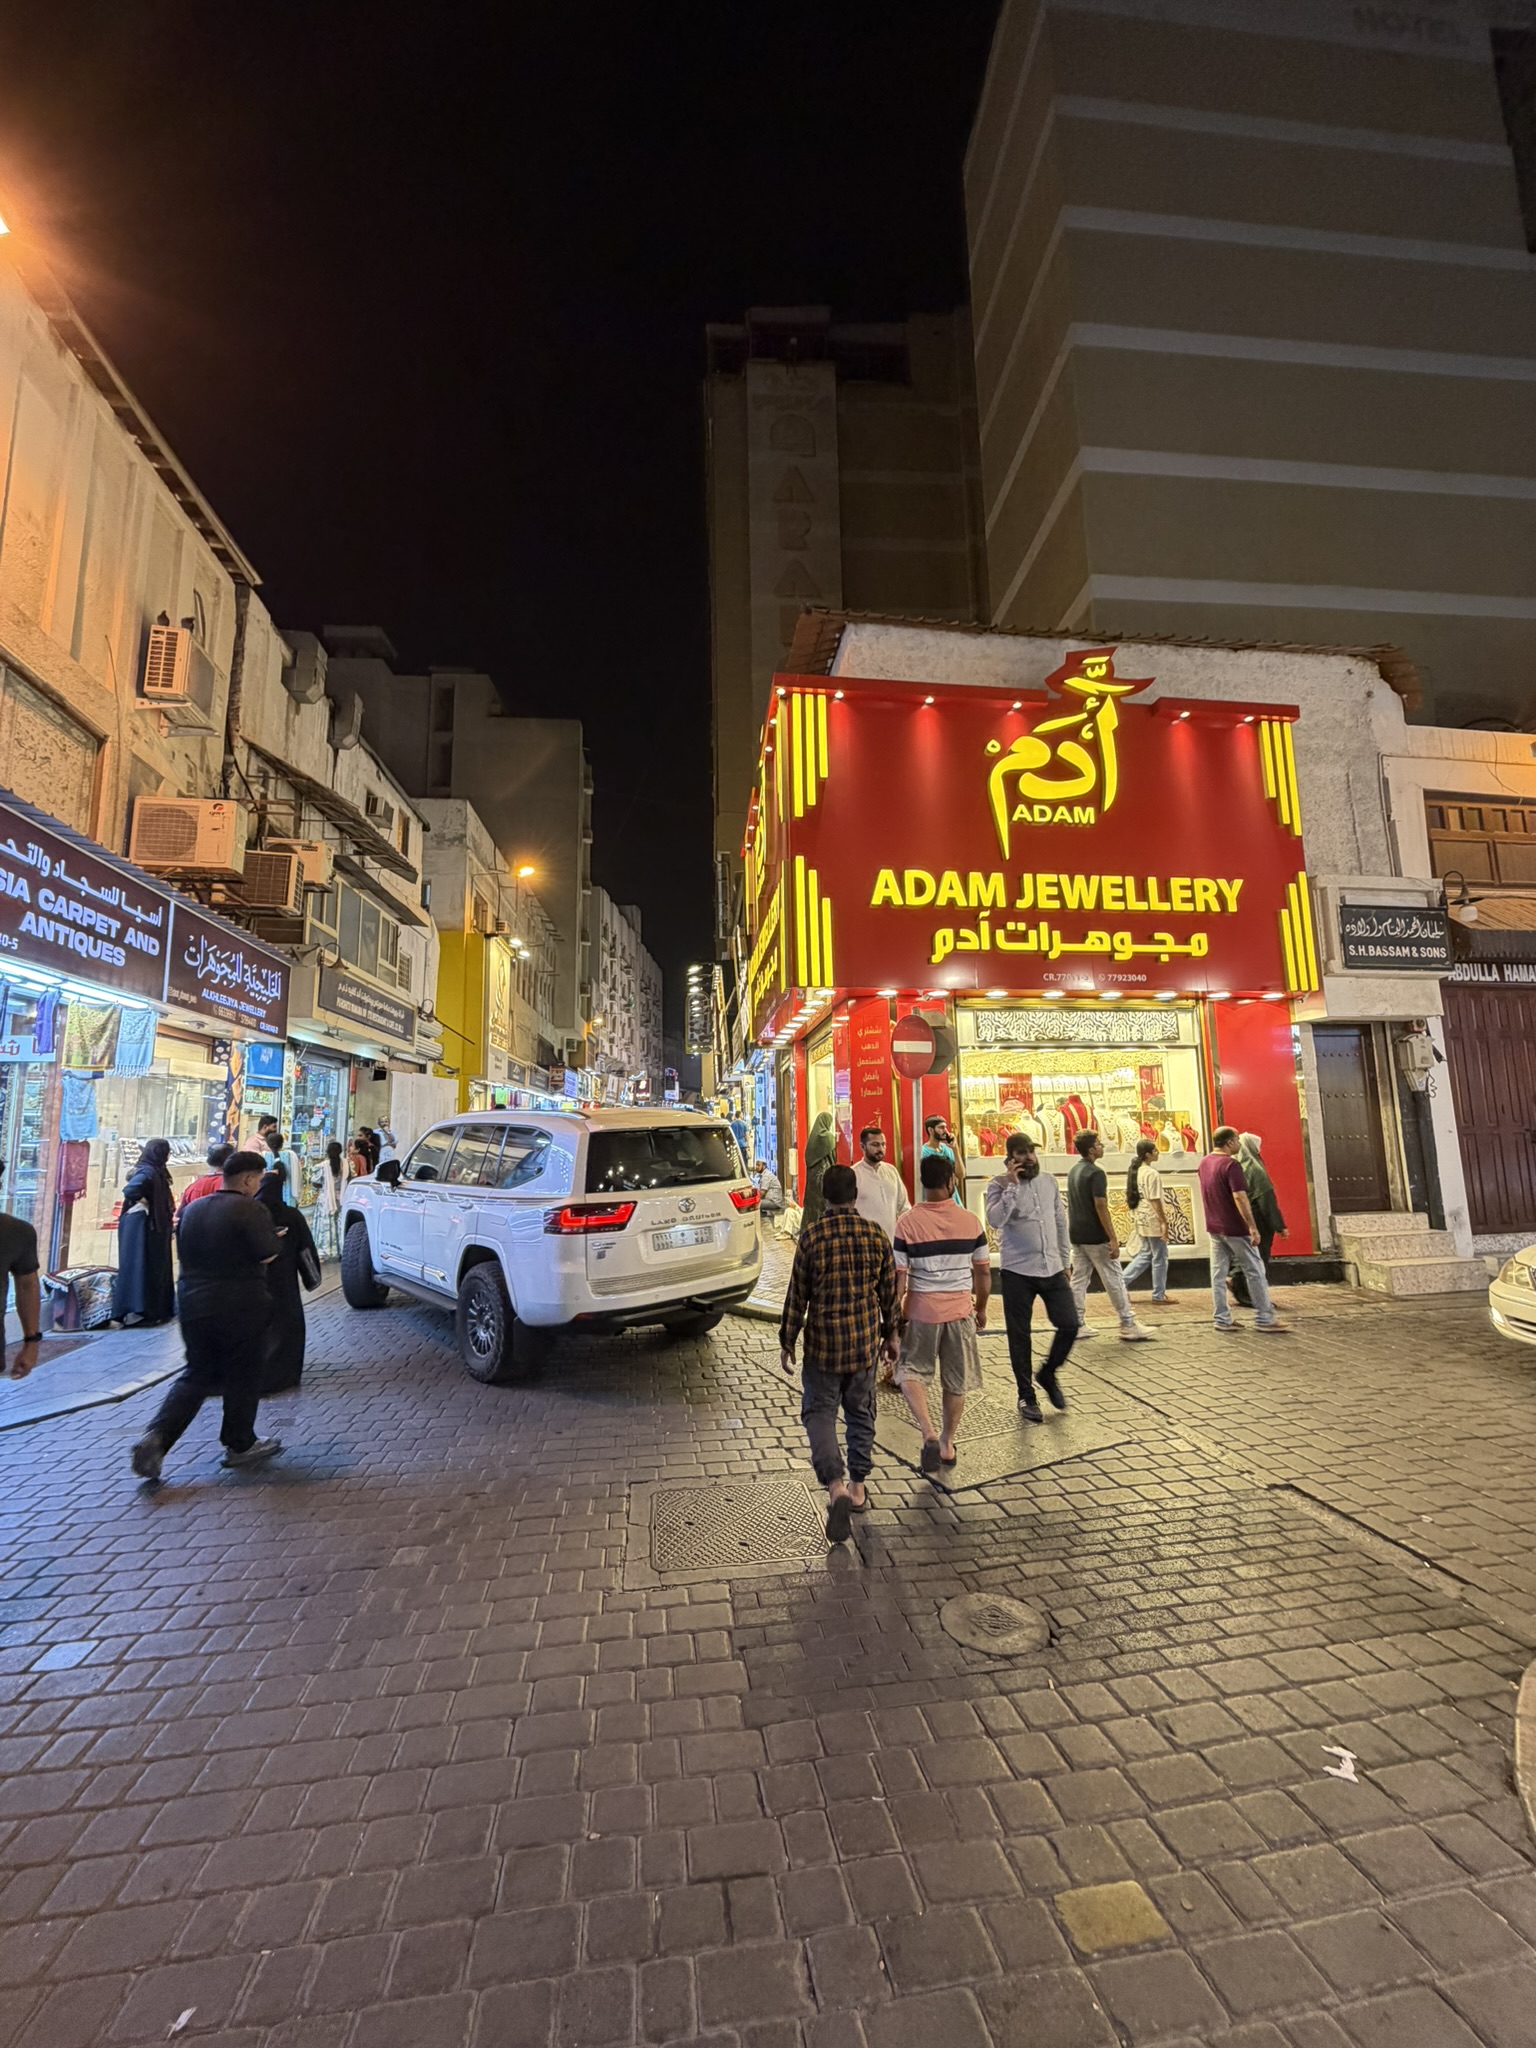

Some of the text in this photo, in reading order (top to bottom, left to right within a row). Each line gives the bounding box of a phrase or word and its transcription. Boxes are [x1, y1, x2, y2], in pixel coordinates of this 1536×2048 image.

[1012, 804, 1095, 824] ADAM
[871, 869, 1243, 913] ADAM JEWELLERY
[19, 911, 126, 967] ANTIQUES
[37, 888, 121, 939] CARPET
[124, 927, 160, 956] AND
[931, 911, 1208, 964] مجوهرات آدم
[1411, 947, 1419, 957] &
[1420, 947, 1447, 958] SONS
[1107, 973, 1147, 983] 77923040
